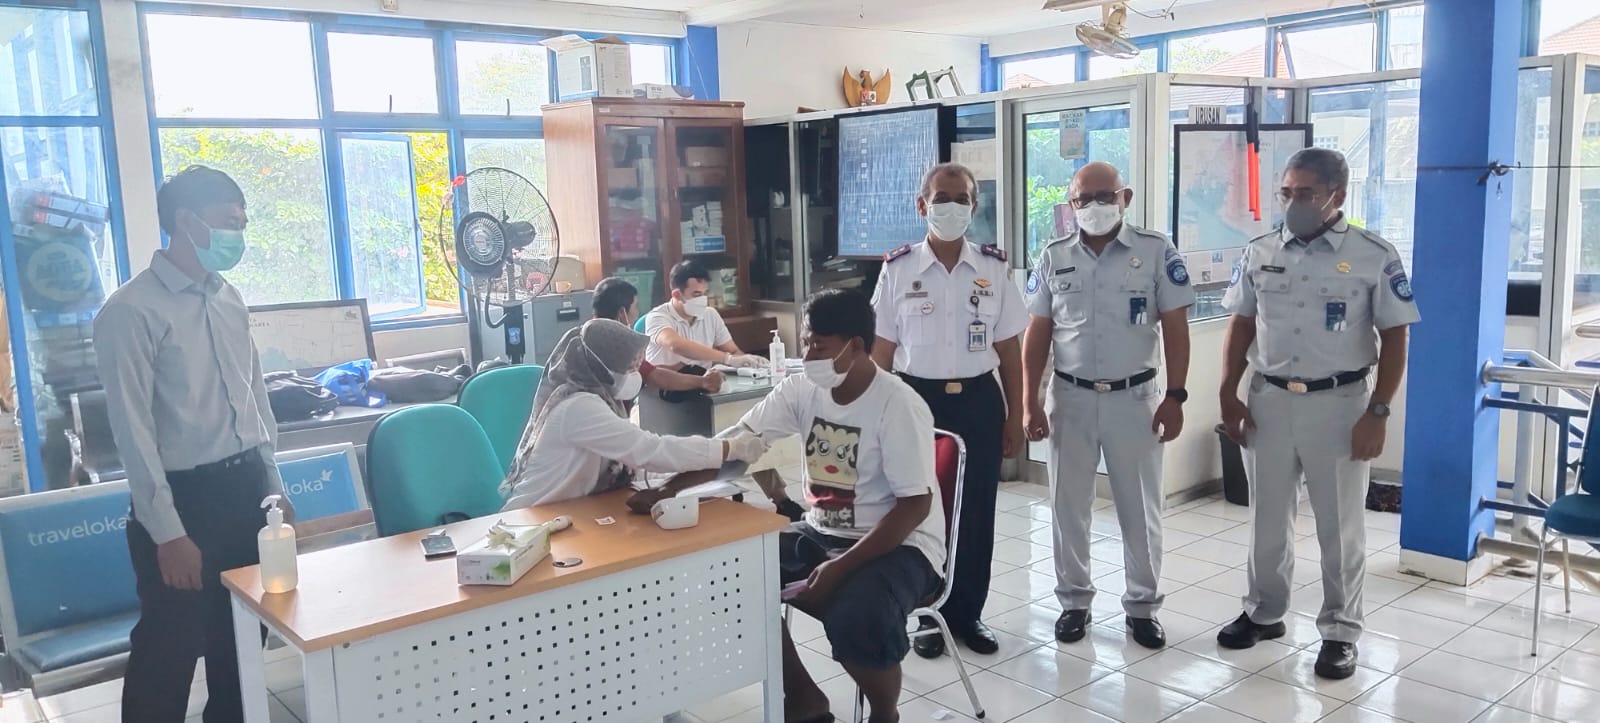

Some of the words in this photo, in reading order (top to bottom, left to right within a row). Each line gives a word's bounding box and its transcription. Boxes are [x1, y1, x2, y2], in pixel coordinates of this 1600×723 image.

[1195, 106, 1221, 125] URUSAN
[285, 478, 324, 496] loka
[28, 516, 128, 546] traveloka
